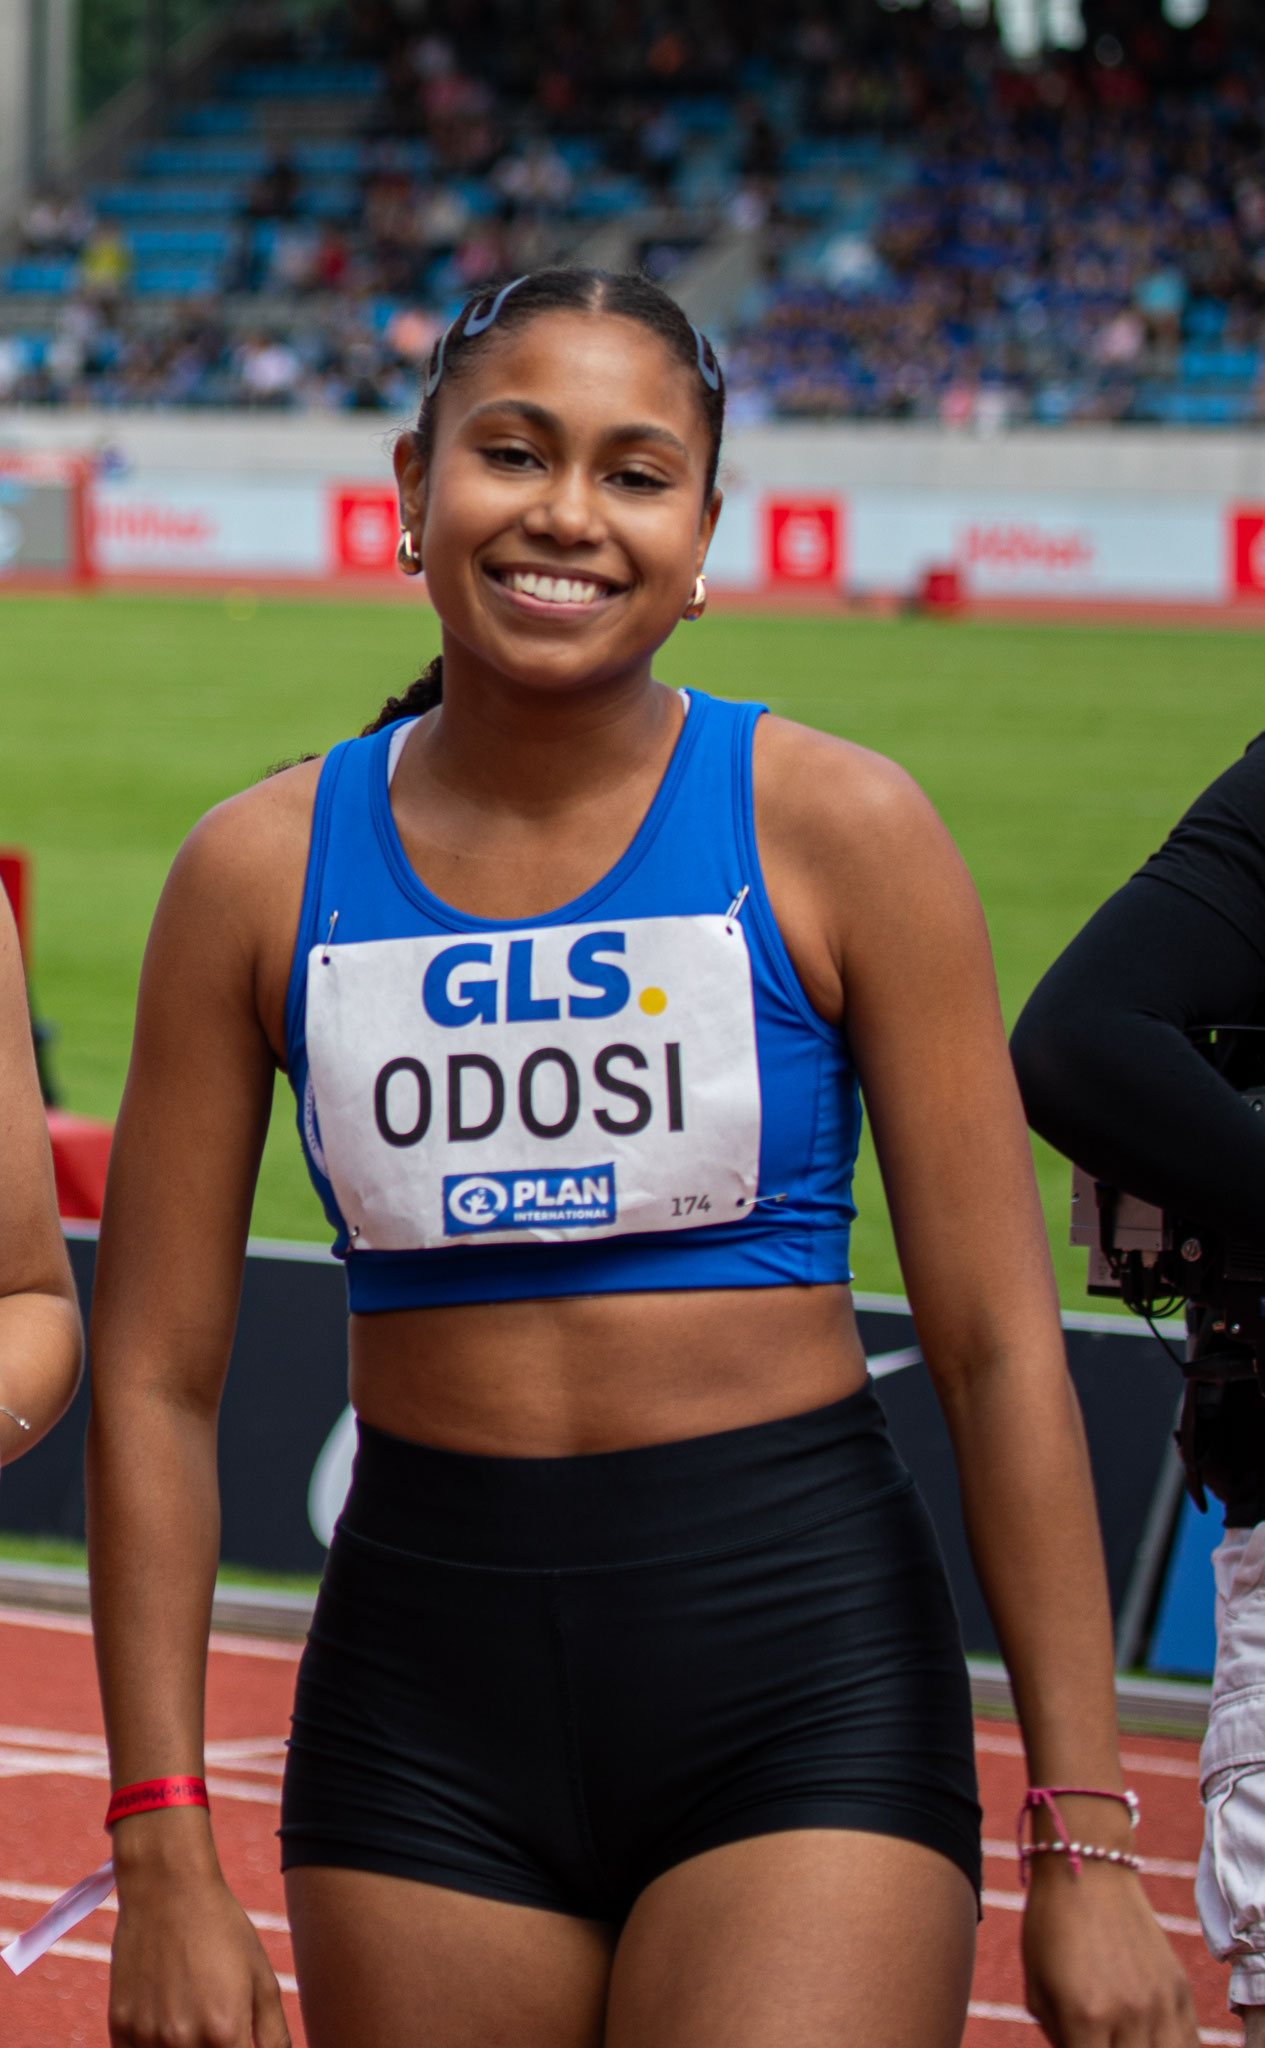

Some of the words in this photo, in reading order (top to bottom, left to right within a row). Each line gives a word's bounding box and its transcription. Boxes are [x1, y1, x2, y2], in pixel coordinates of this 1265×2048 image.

[373, 1041, 685, 1149] ODOSI
[513, 1177, 609, 1208] PLAN
[670, 1194, 712, 1217] 174
[514, 1208, 609, 1222] INTERNATIONAL
